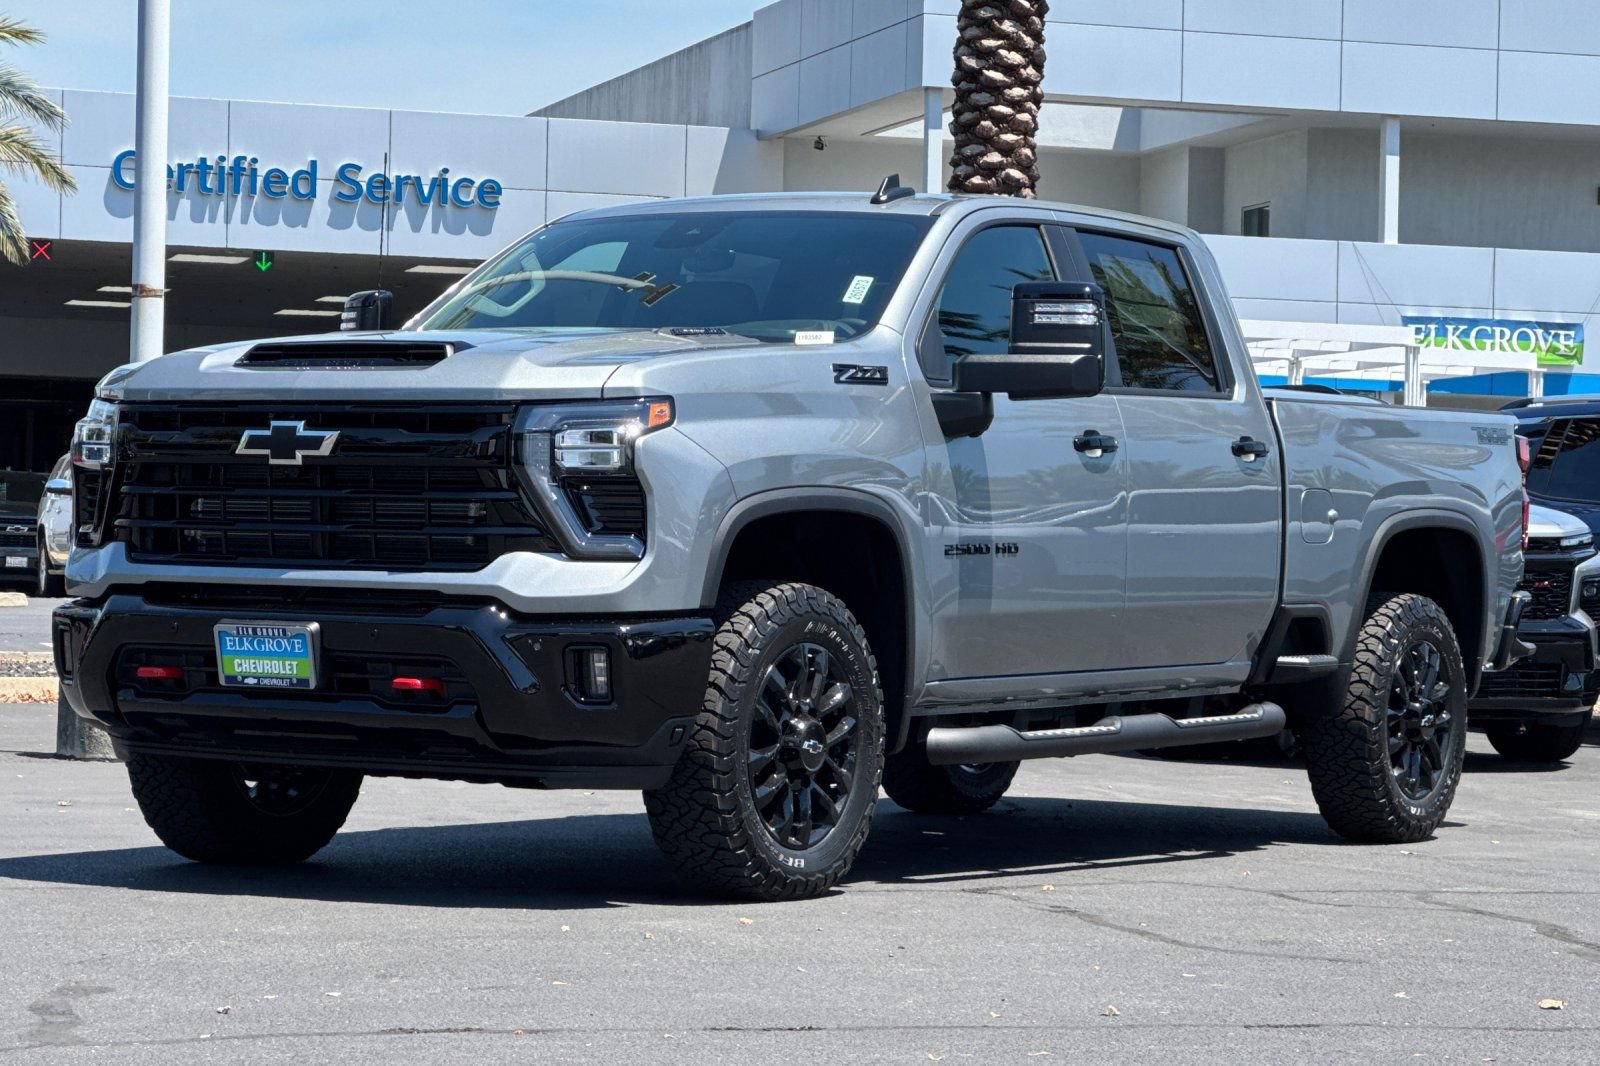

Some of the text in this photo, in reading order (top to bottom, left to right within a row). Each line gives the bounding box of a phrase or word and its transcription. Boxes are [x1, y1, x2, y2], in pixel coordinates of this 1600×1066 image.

[112, 150, 502, 208] Crtified Service
[944, 543, 1019, 556] 2500 HD
[257, 628, 283, 636] GROVE
[234, 659, 298, 675] CHEVROLET
[260, 678, 290, 686] CHEVROLET
